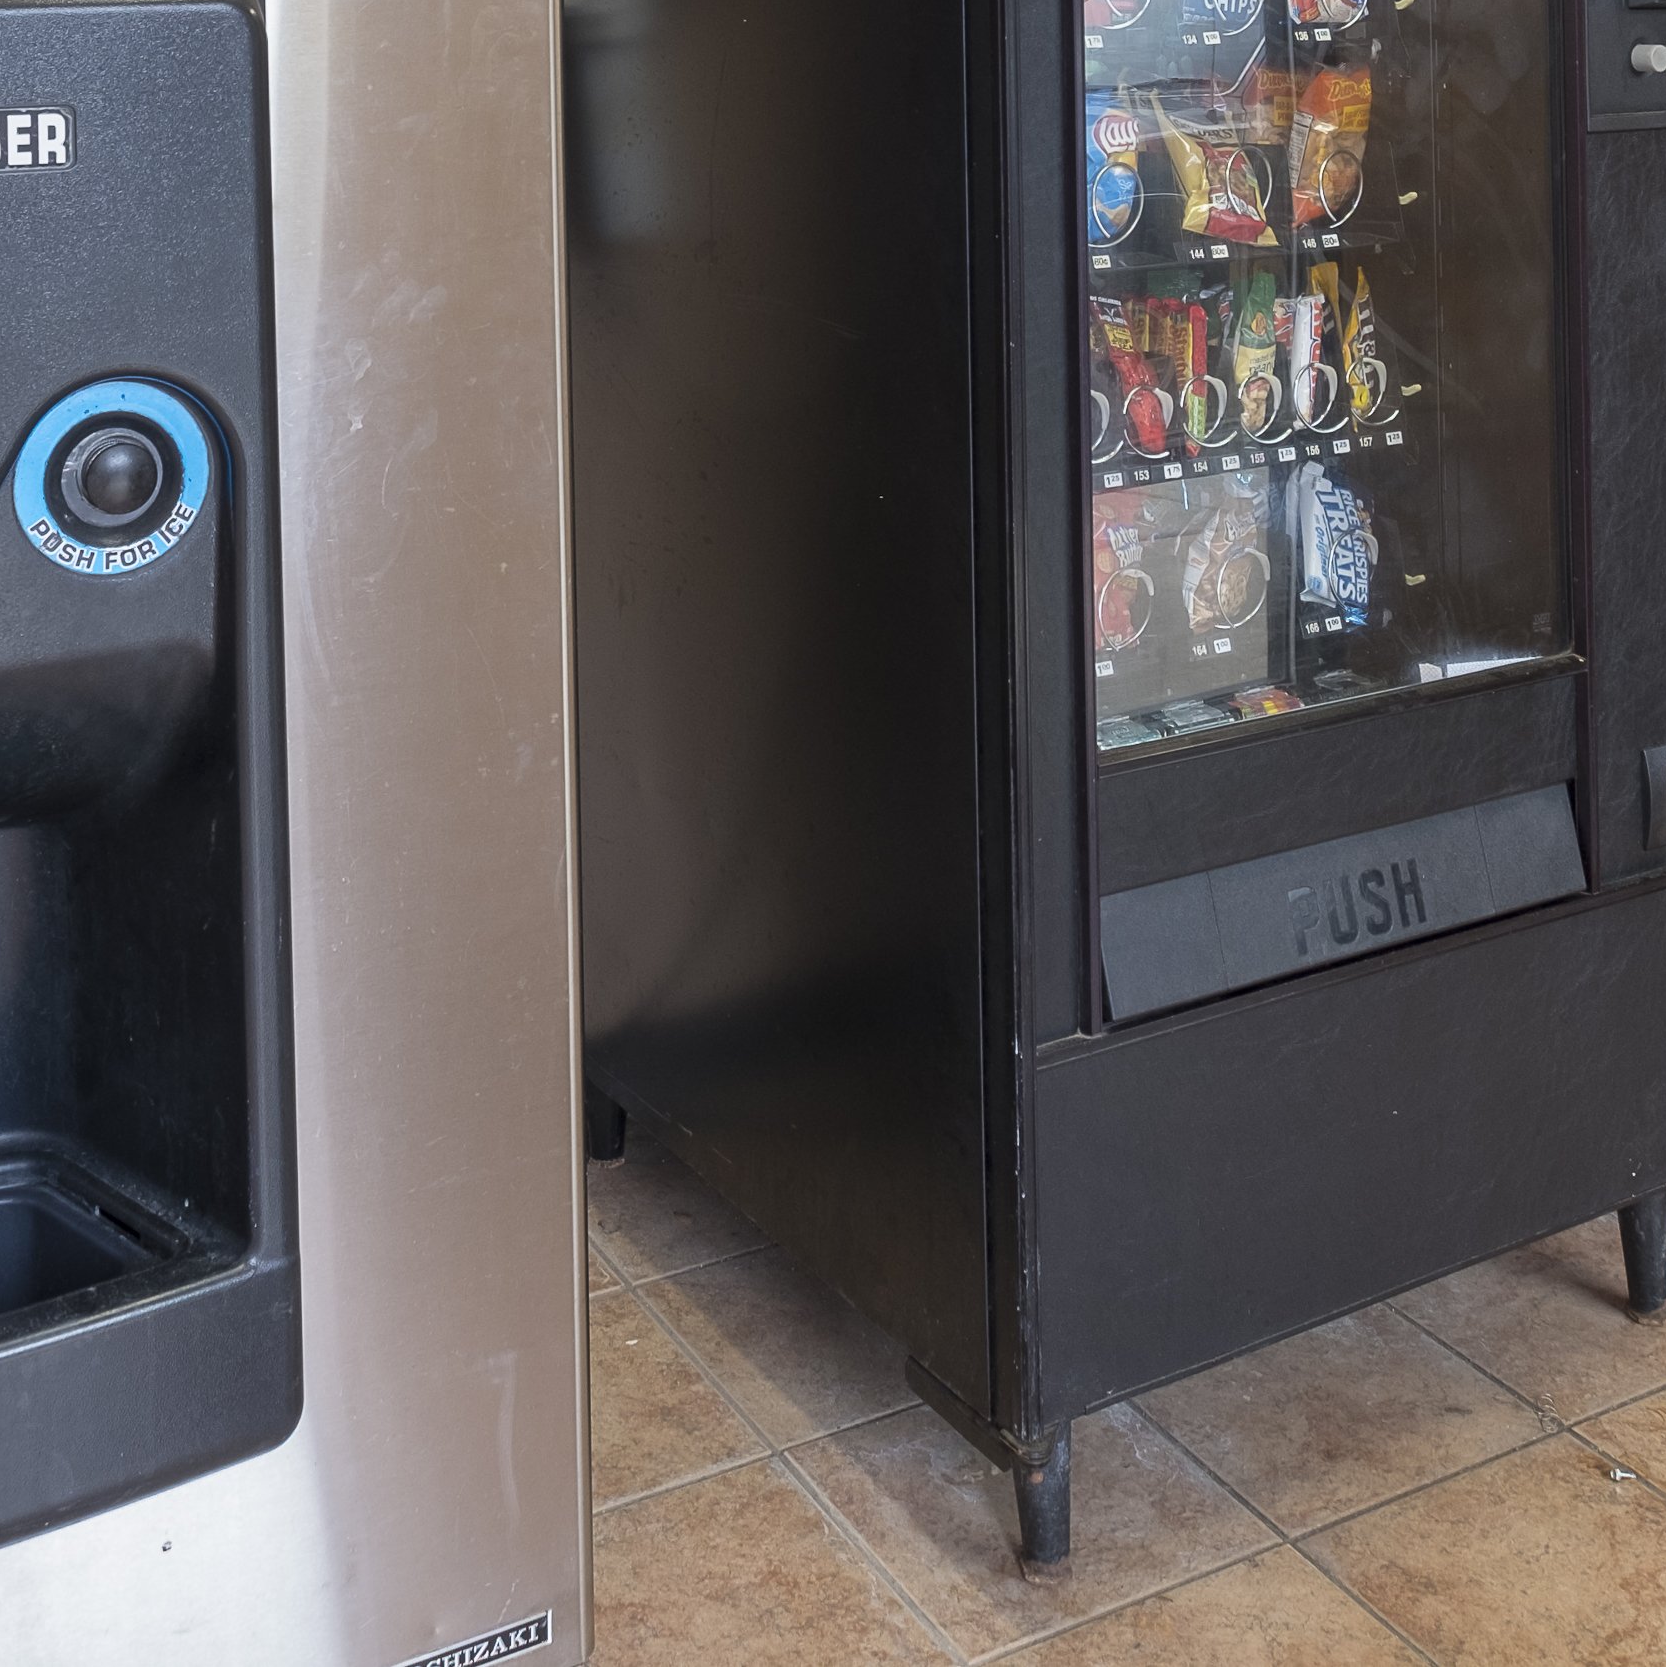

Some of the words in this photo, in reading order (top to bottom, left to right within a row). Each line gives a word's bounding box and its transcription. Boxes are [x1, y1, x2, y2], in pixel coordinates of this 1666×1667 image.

[1190, 249, 1205, 260] 144
[1359, 436, 1373, 447] 157
[1193, 462, 1208, 473] 154
[1134, 470, 1150, 481] 153
[1340, 489, 1360, 527] RICE
[29, 517, 96, 570] PUSH
[103, 540, 157, 570] FOR
[159, 502, 196, 544] ICE
[1315, 526, 1330, 578] Original
[1192, 644, 1207, 656] 164
[1287, 857, 1427, 957] PUSH
